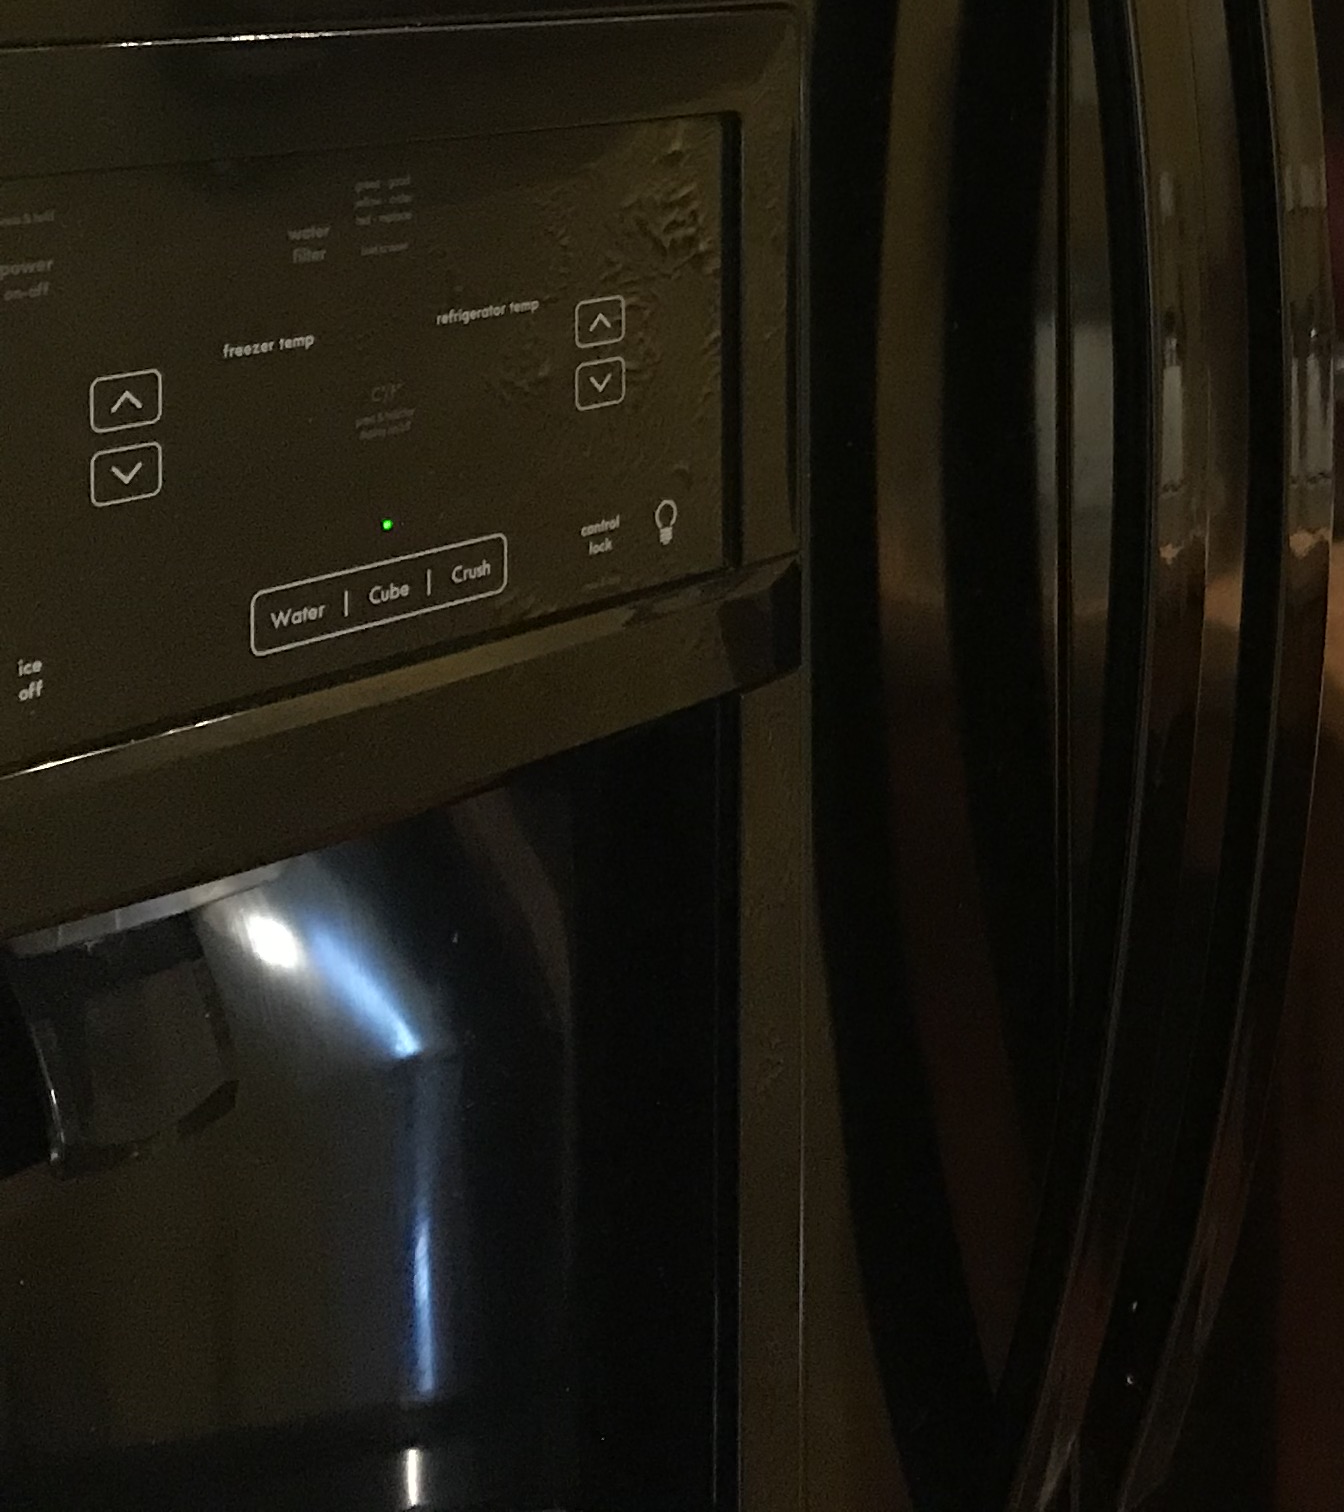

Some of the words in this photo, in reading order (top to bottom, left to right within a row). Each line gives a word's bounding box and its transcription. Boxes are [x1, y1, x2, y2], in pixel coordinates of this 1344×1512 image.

[436, 303, 507, 326] refrigerator
[509, 297, 541, 315] temp
[222, 338, 275, 360] freezer
[279, 333, 315, 351] temp
[580, 513, 621, 537] control
[588, 538, 613, 556] lock
[269, 601, 326, 631] Water
[368, 582, 411, 606] Cube
[451, 561, 492, 585] Crush
[17, 656, 43, 678] ice
[18, 679, 44, 703] off
